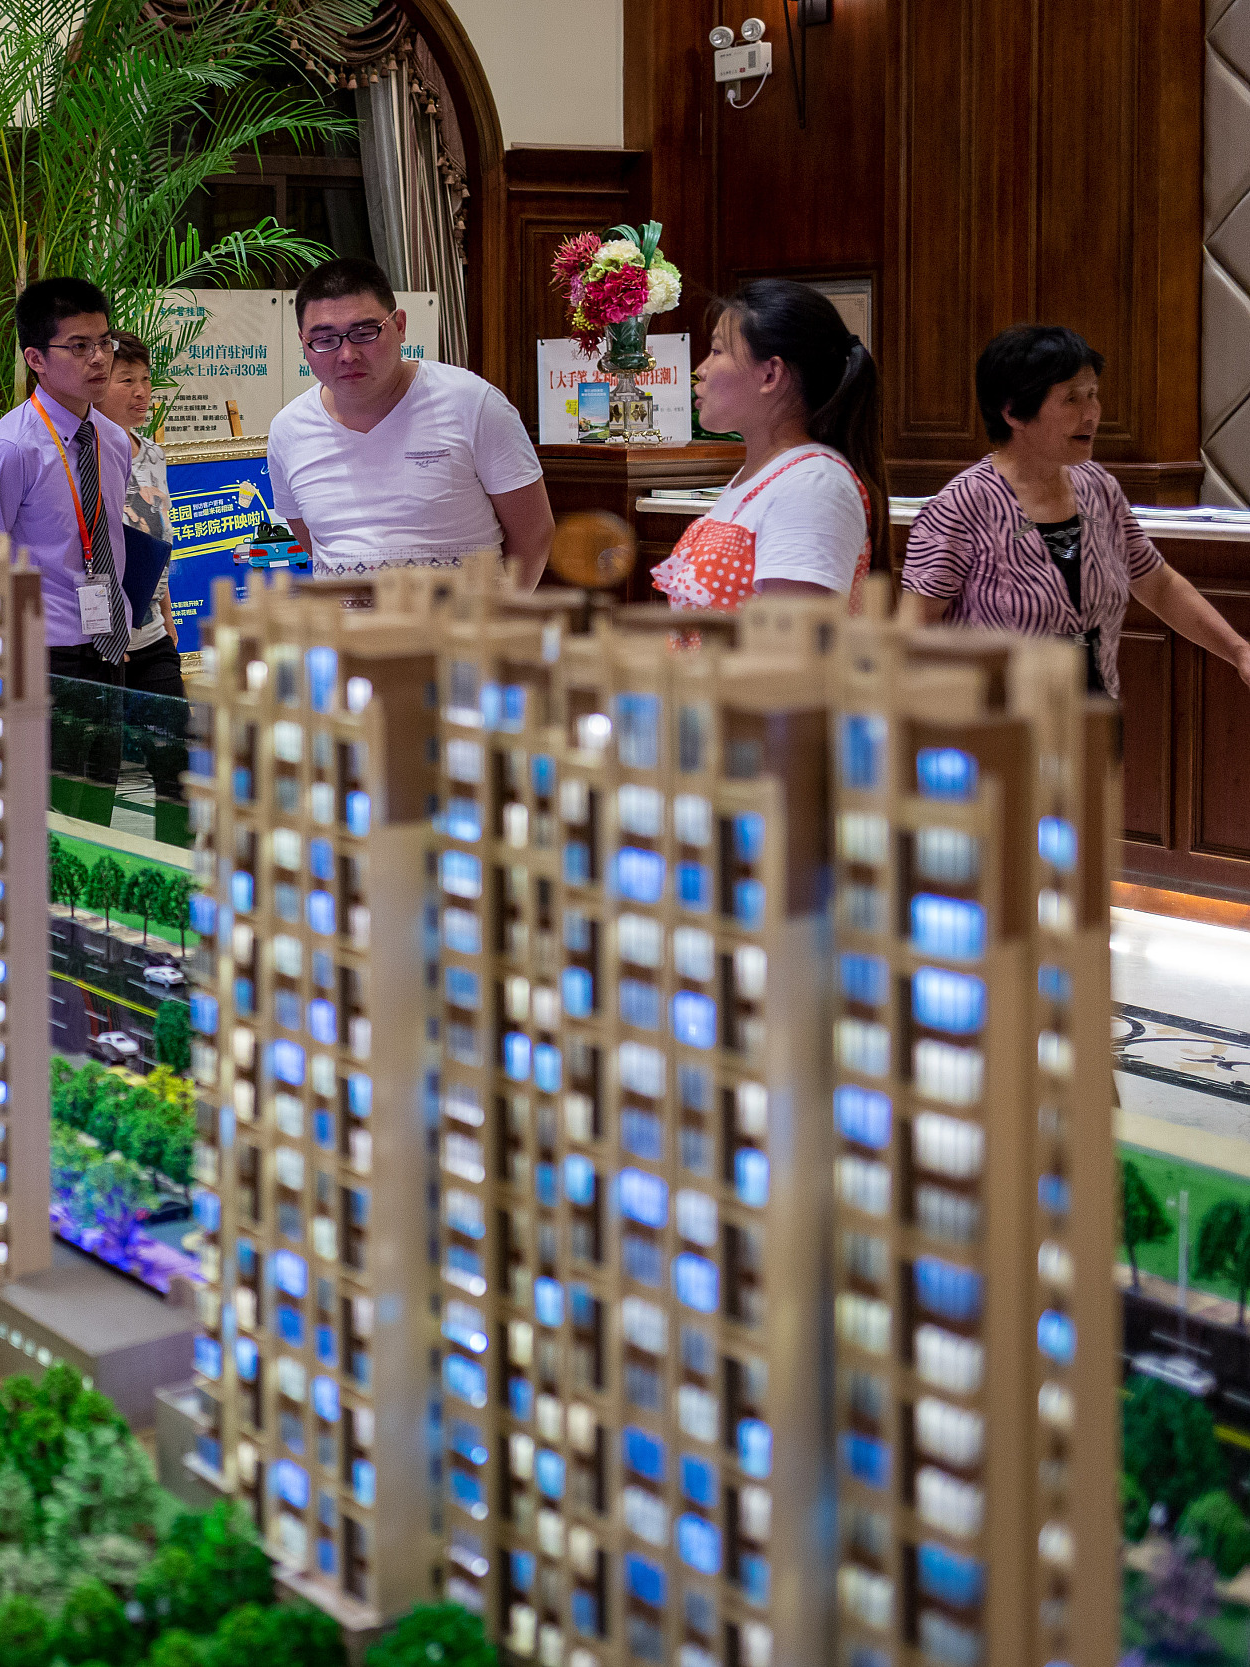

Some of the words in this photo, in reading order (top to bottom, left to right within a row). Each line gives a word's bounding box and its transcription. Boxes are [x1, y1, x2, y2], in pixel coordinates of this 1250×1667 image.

[152, 345, 267, 359] 集团首驻河南
[150, 363, 268, 377] 亚太上市公司30强
